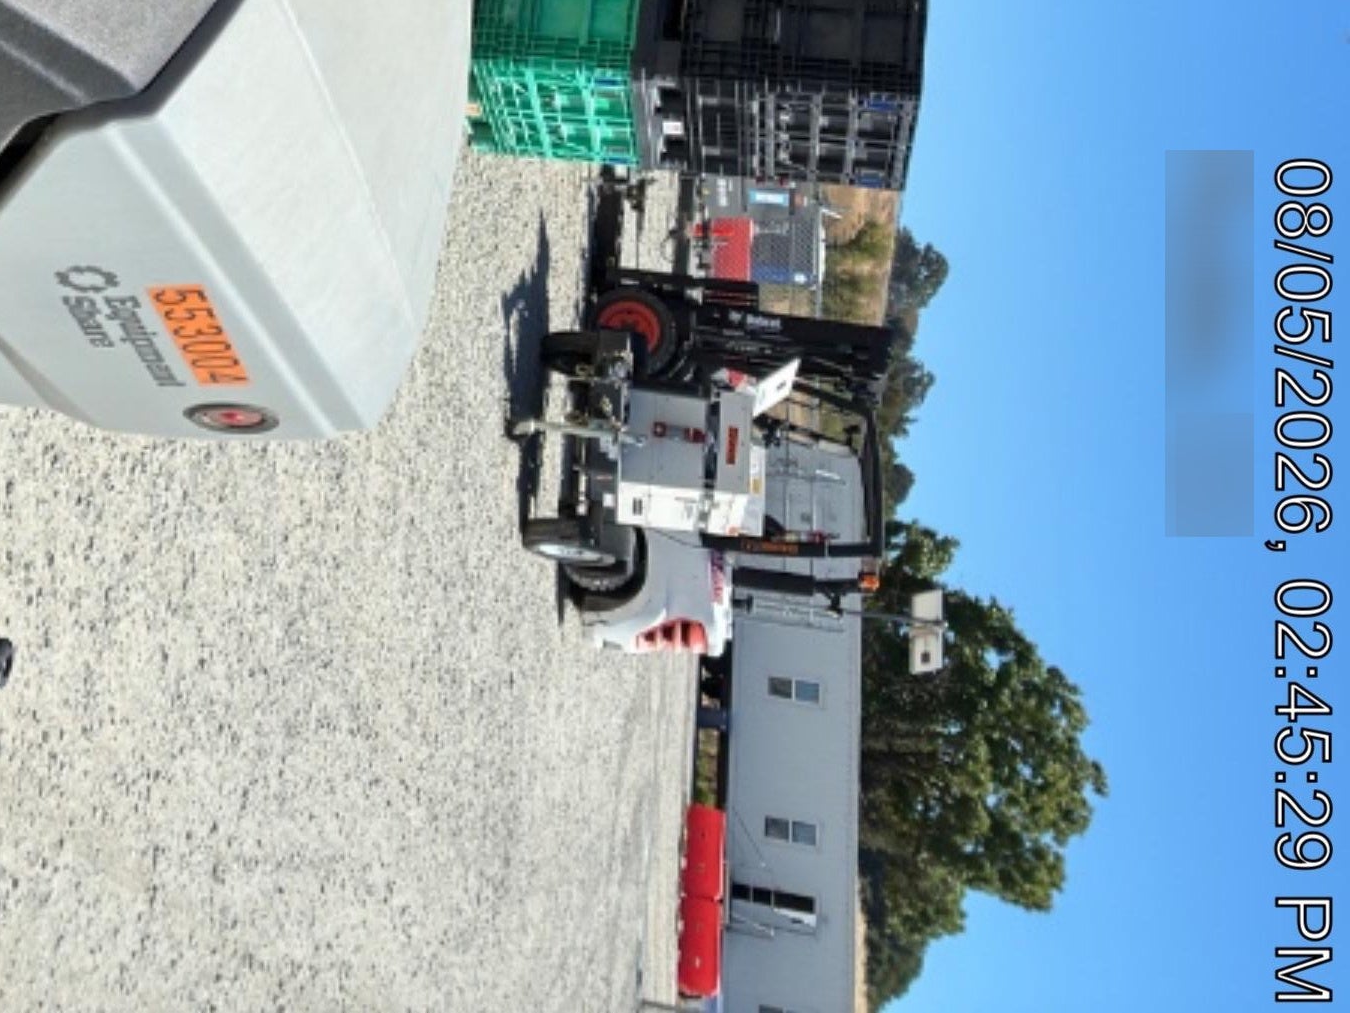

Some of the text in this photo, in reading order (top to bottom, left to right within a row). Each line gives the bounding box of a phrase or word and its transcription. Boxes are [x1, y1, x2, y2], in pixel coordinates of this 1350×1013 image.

[62, 295, 116, 349] Share
[102, 295, 188, 387] Equipment
[153, 289, 249, 384] 553004
